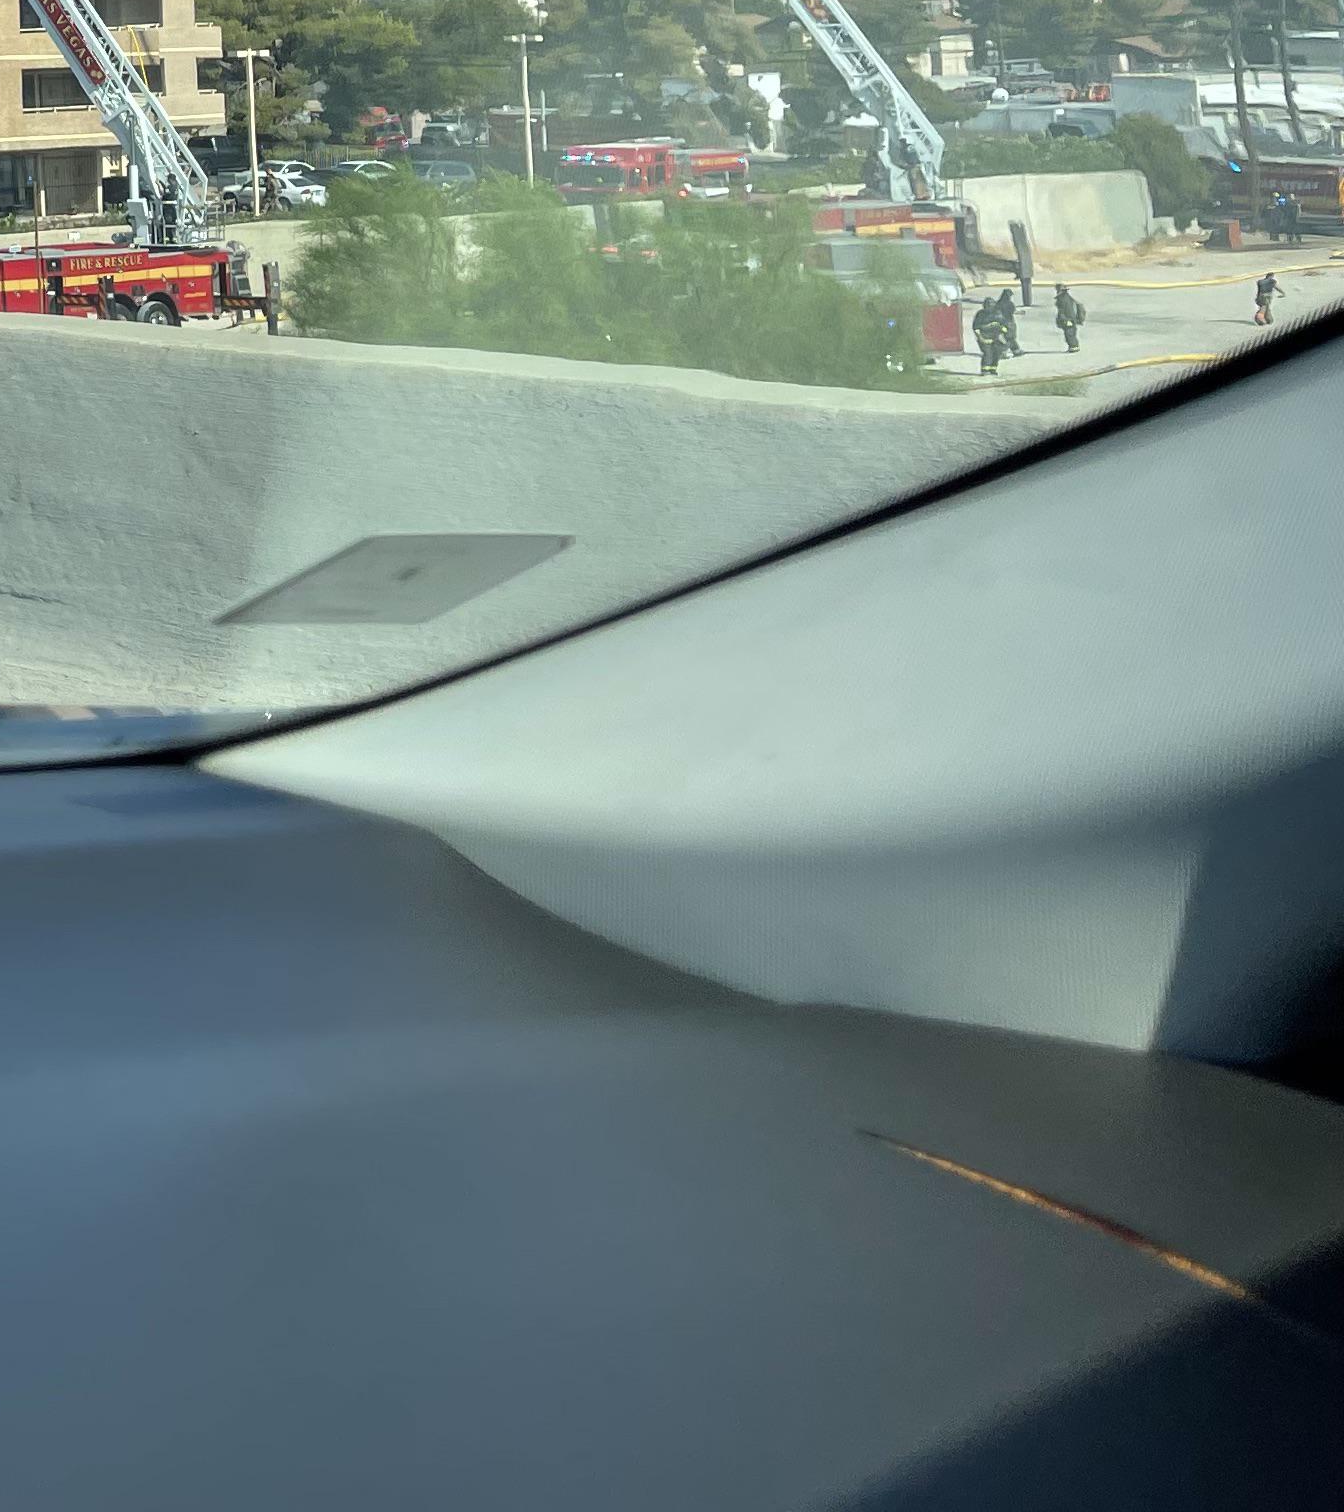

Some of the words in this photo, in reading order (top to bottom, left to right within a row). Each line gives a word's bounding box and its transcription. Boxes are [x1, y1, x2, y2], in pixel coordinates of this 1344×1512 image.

[56, 14, 93, 68] VEGAS
[70, 258, 93, 271] FIRE
[95, 259, 102, 268] &
[104, 254, 143, 267] RESCUE
